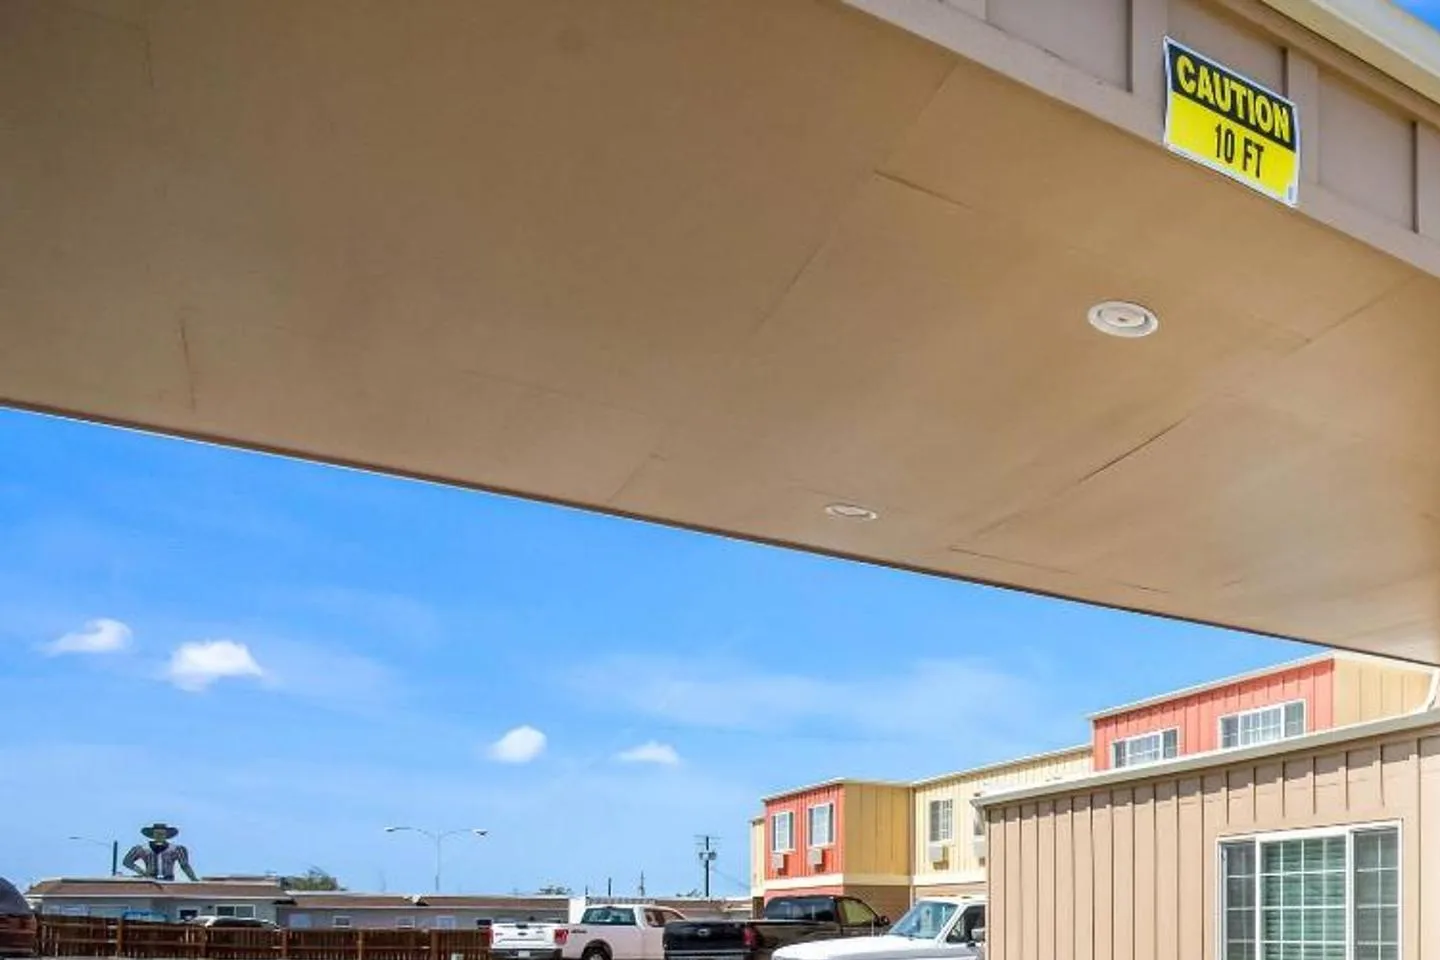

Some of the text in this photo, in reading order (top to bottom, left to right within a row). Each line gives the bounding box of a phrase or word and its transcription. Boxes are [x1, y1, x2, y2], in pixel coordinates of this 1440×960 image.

[1176, 55, 1290, 142] CAUTION
[1214, 123, 1264, 178] 10 FT
